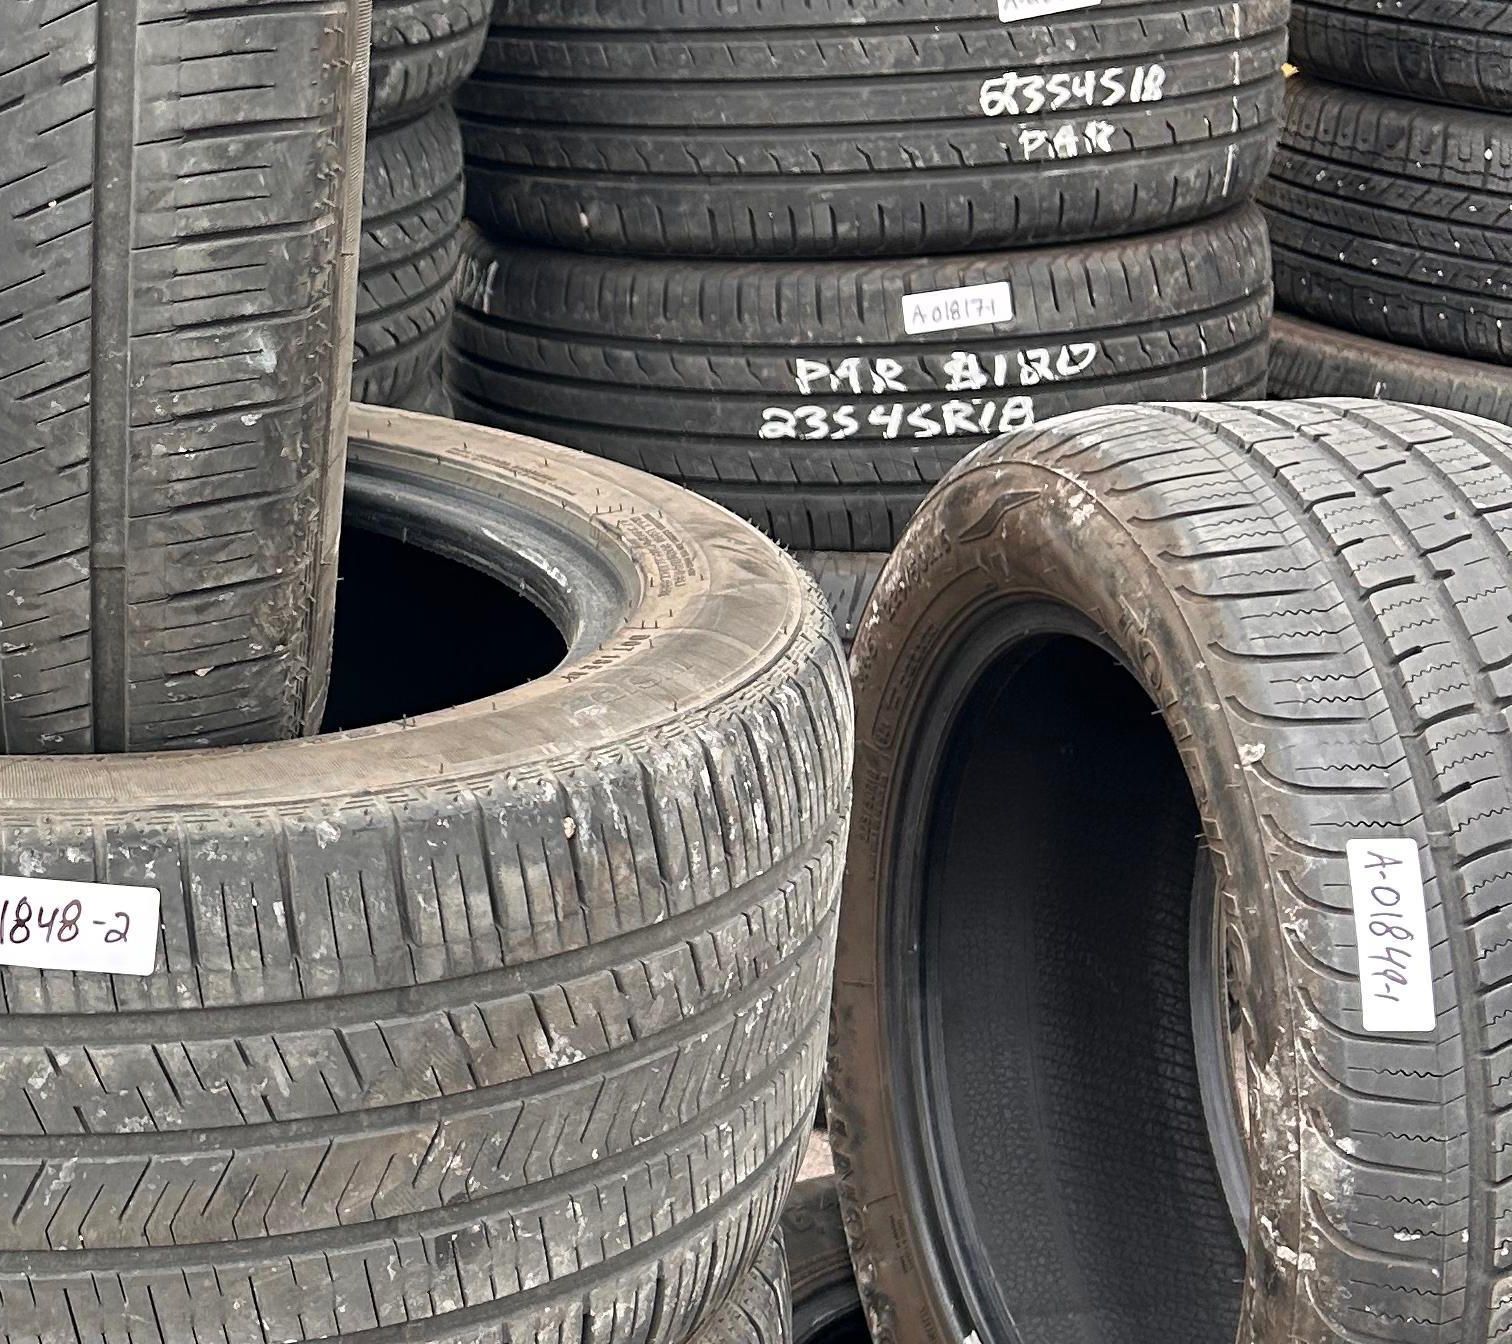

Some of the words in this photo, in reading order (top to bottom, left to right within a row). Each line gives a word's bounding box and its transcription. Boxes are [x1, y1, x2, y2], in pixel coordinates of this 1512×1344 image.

[1018, 120, 1116, 160] PAR
[794, 357, 908, 394] PAR
[1363, 850, 1415, 1002] A-01849-1
